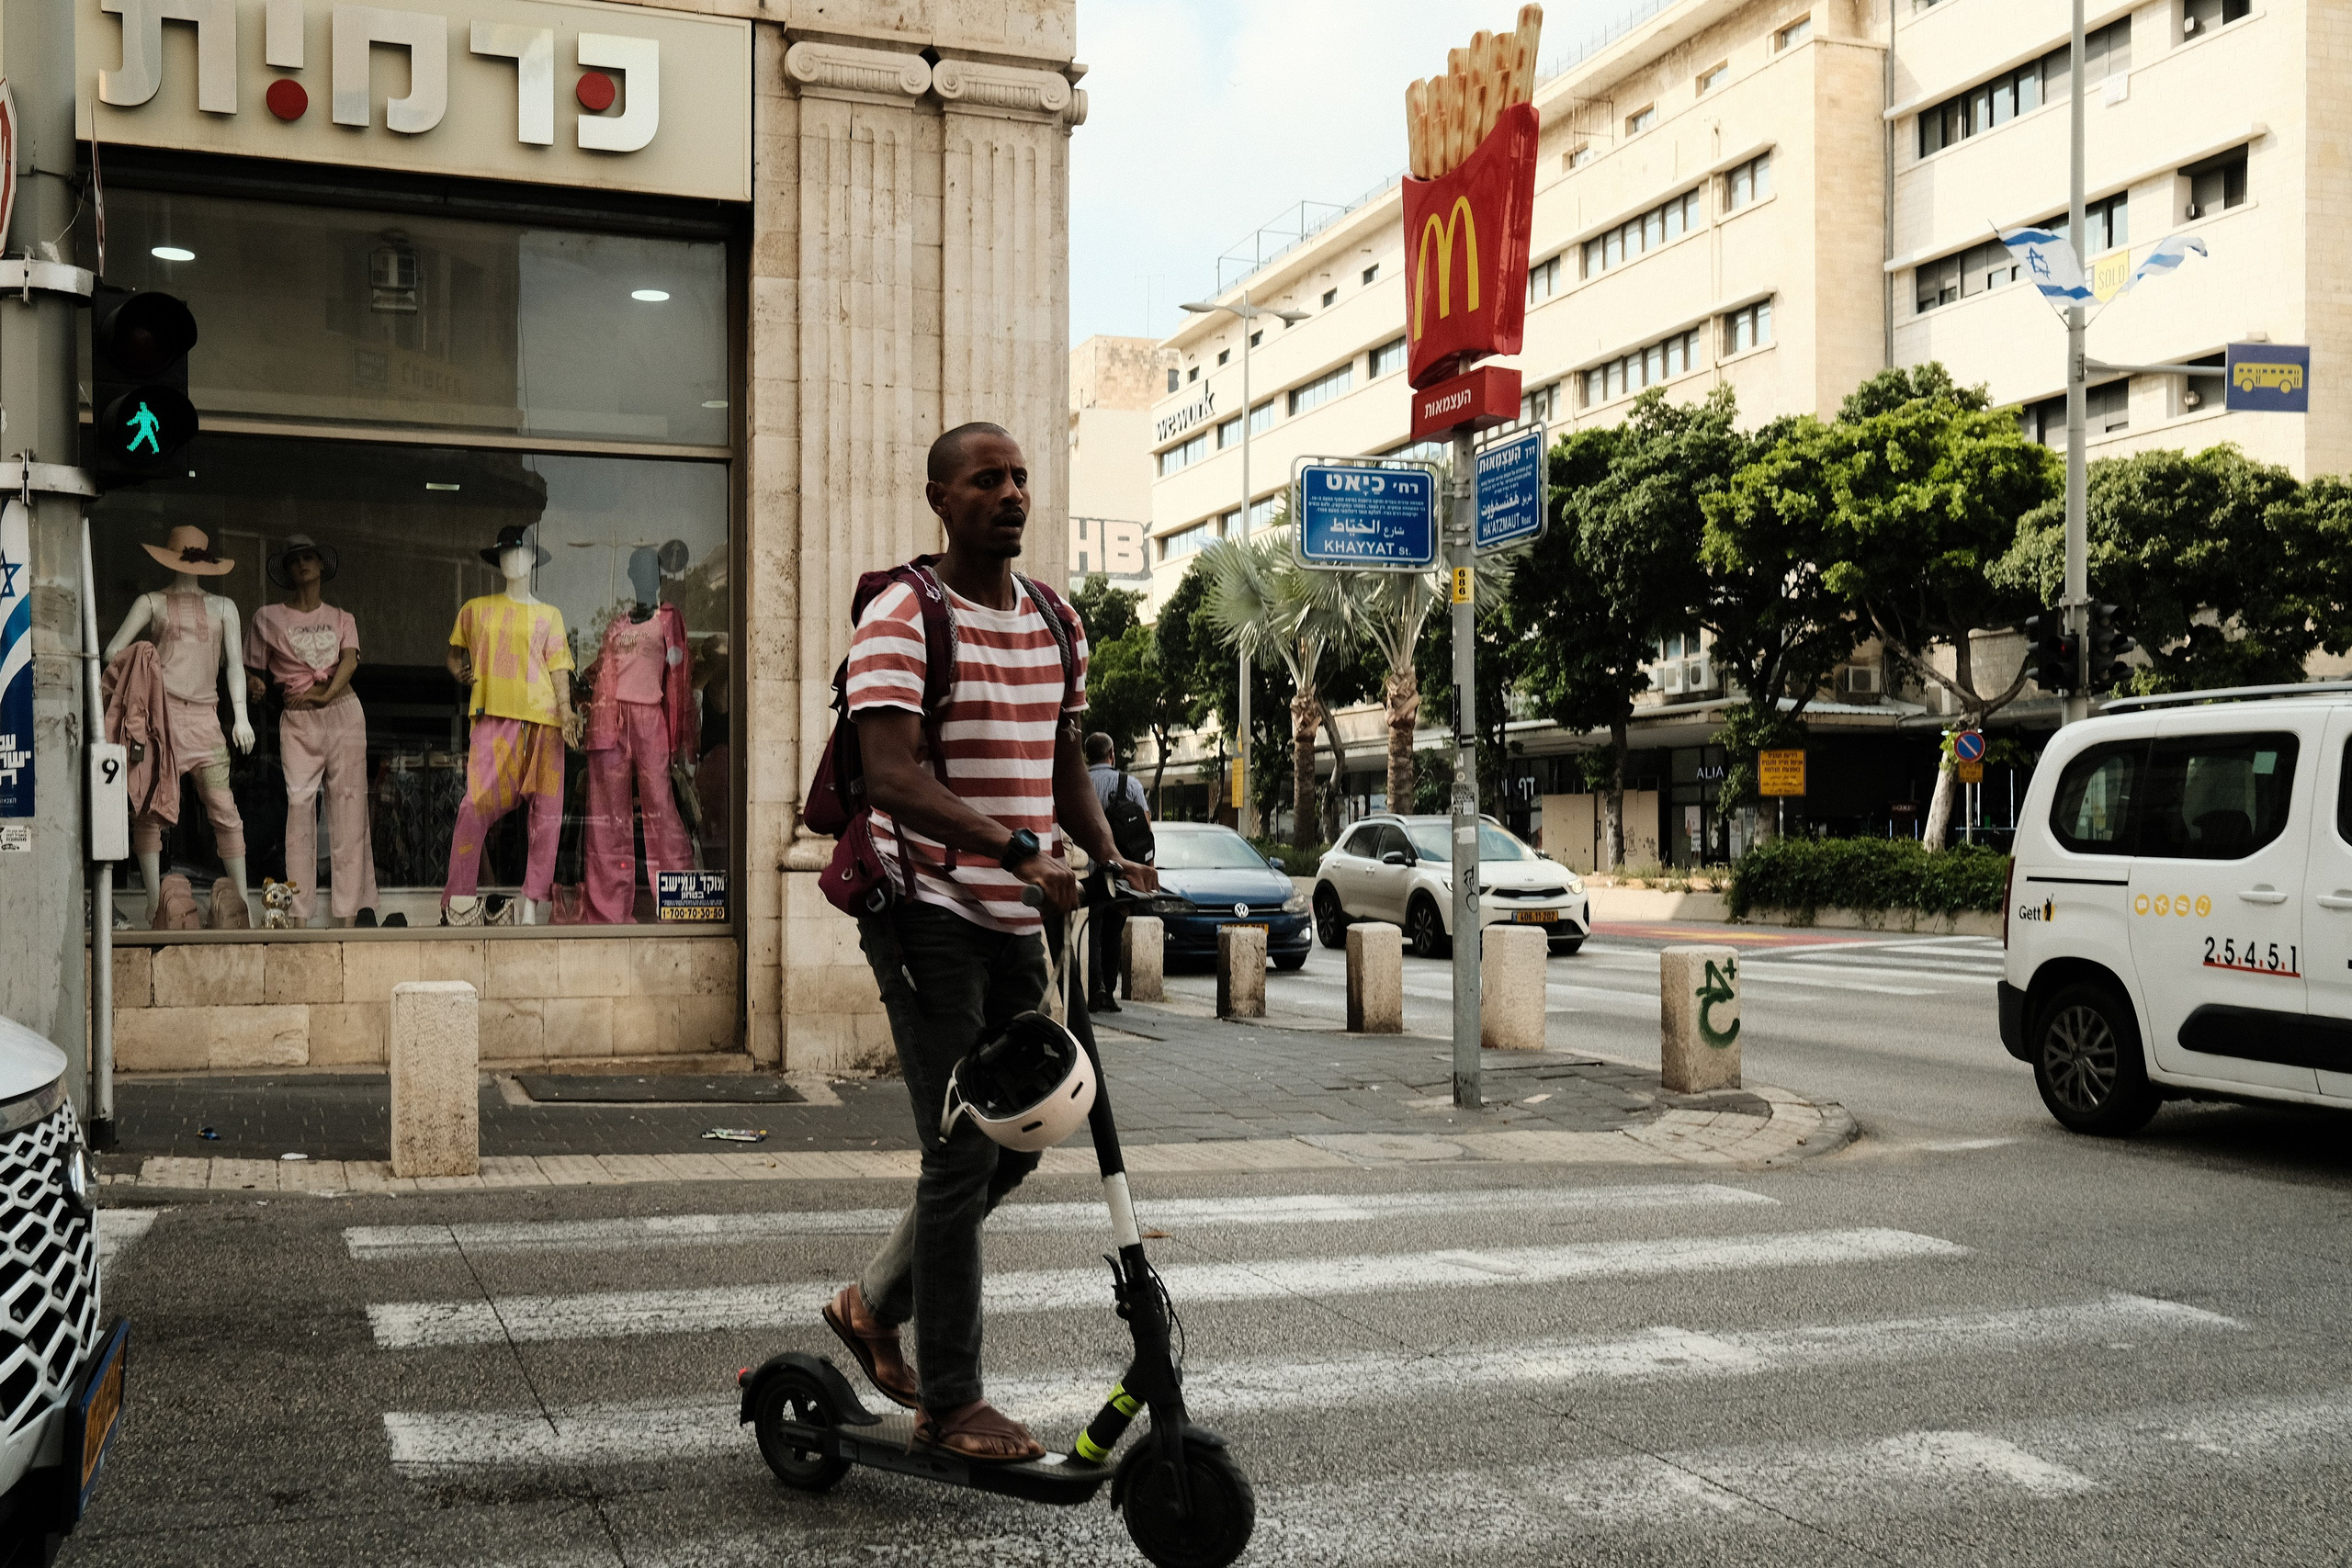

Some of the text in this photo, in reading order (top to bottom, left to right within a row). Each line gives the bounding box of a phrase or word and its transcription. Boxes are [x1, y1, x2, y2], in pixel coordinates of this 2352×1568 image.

[2098, 265, 2125, 290] SOLD
[1155, 378, 1216, 442] wework
[1424, 388, 1472, 420] העצמאות
[1384, 525, 1405, 538] شارع
[1482, 513, 1532, 538] HA'ATZMAUT Road
[1324, 539, 1412, 557] KHAYYAT St.
[101, 758, 119, 785] 9
[1696, 765, 1724, 779] ALIA
[700, 875, 725, 895] מוקד
[2018, 905, 2041, 921] Gett
